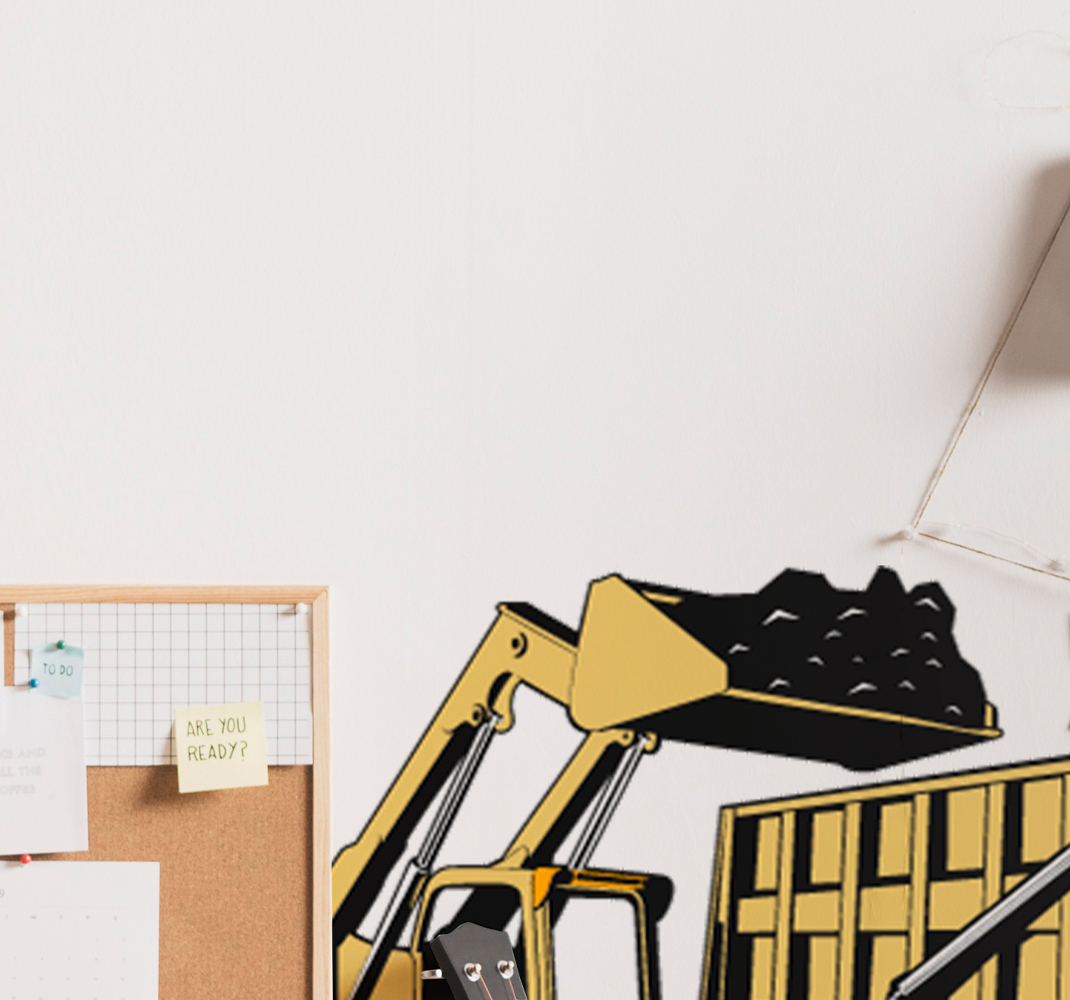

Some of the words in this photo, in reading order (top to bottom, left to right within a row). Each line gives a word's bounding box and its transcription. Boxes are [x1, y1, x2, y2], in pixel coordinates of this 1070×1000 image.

[42, 662, 56, 676] TO
[59, 664, 74, 677] DO
[186, 718, 214, 737] ARE
[218, 715, 247, 734] YOU
[187, 739, 248, 762] READY?
